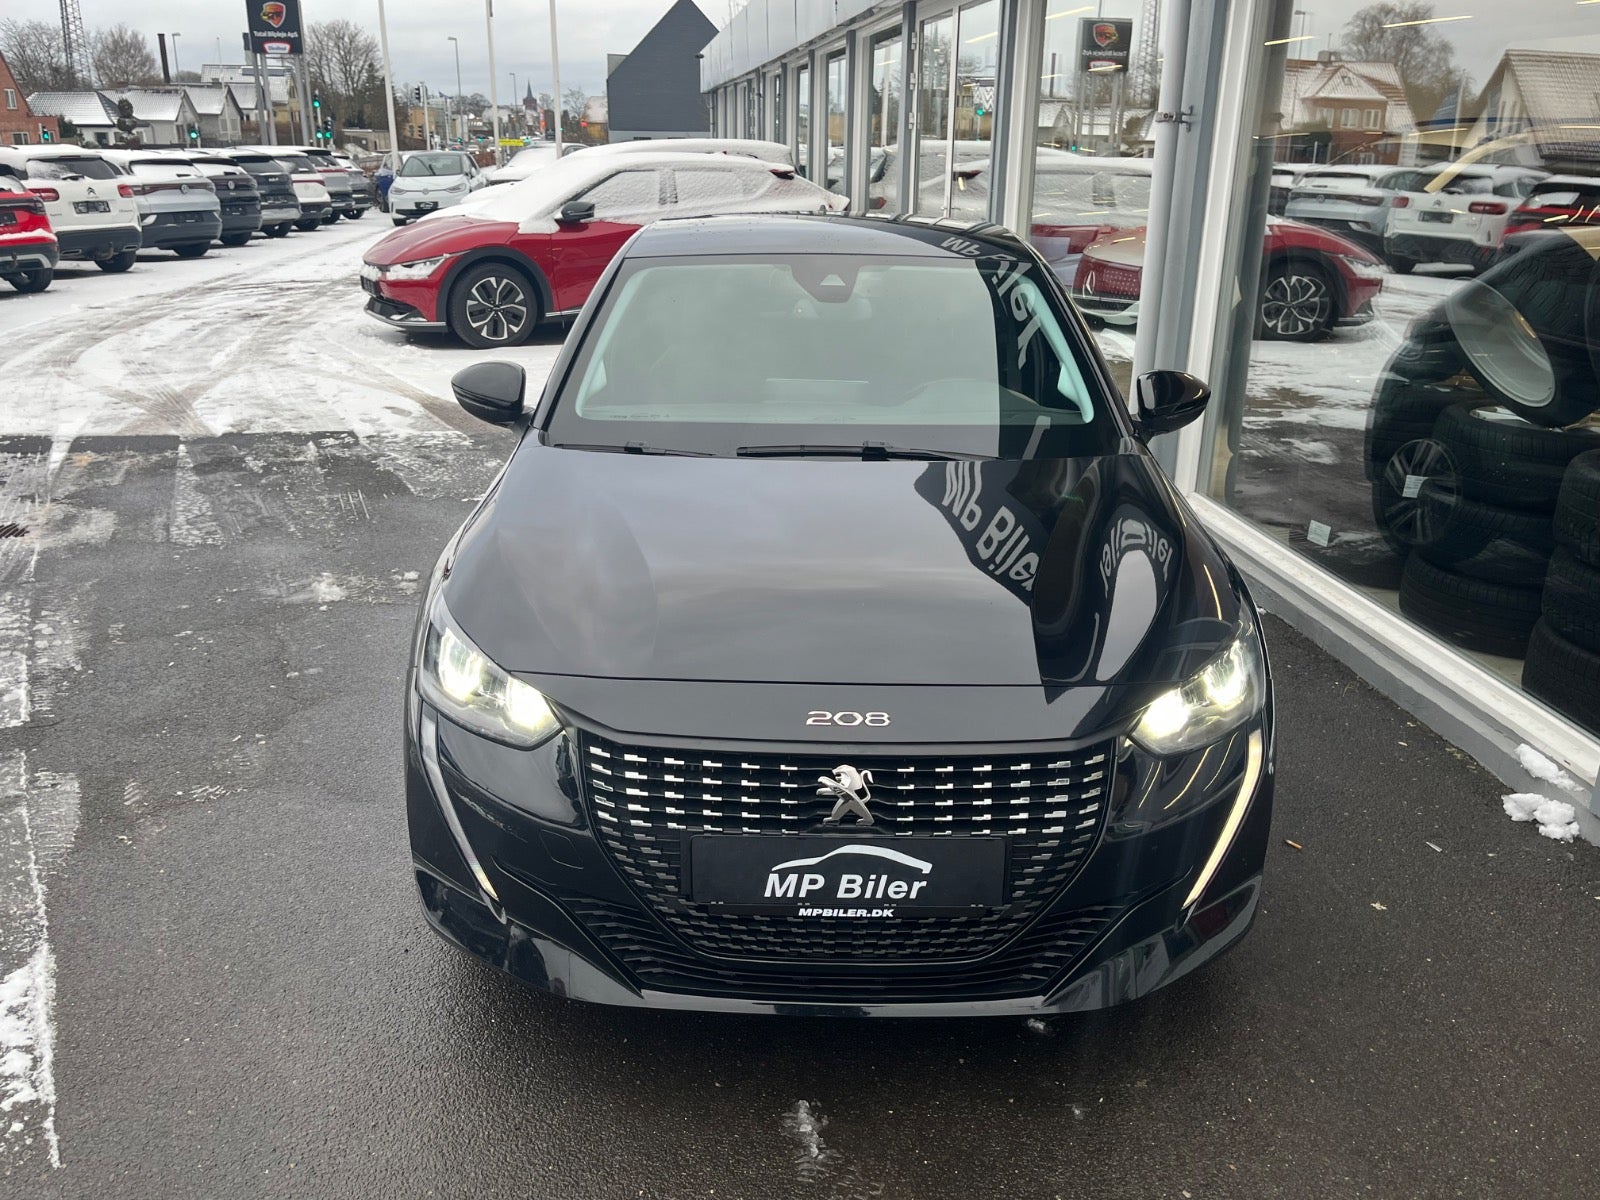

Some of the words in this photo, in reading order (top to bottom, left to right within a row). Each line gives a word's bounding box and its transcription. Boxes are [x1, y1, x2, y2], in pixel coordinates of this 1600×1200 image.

[806, 710, 891, 726] 208
[763, 873, 825, 898] MP
[836, 874, 927, 899] Biler
[798, 907, 894, 918] MPBILER.DK
